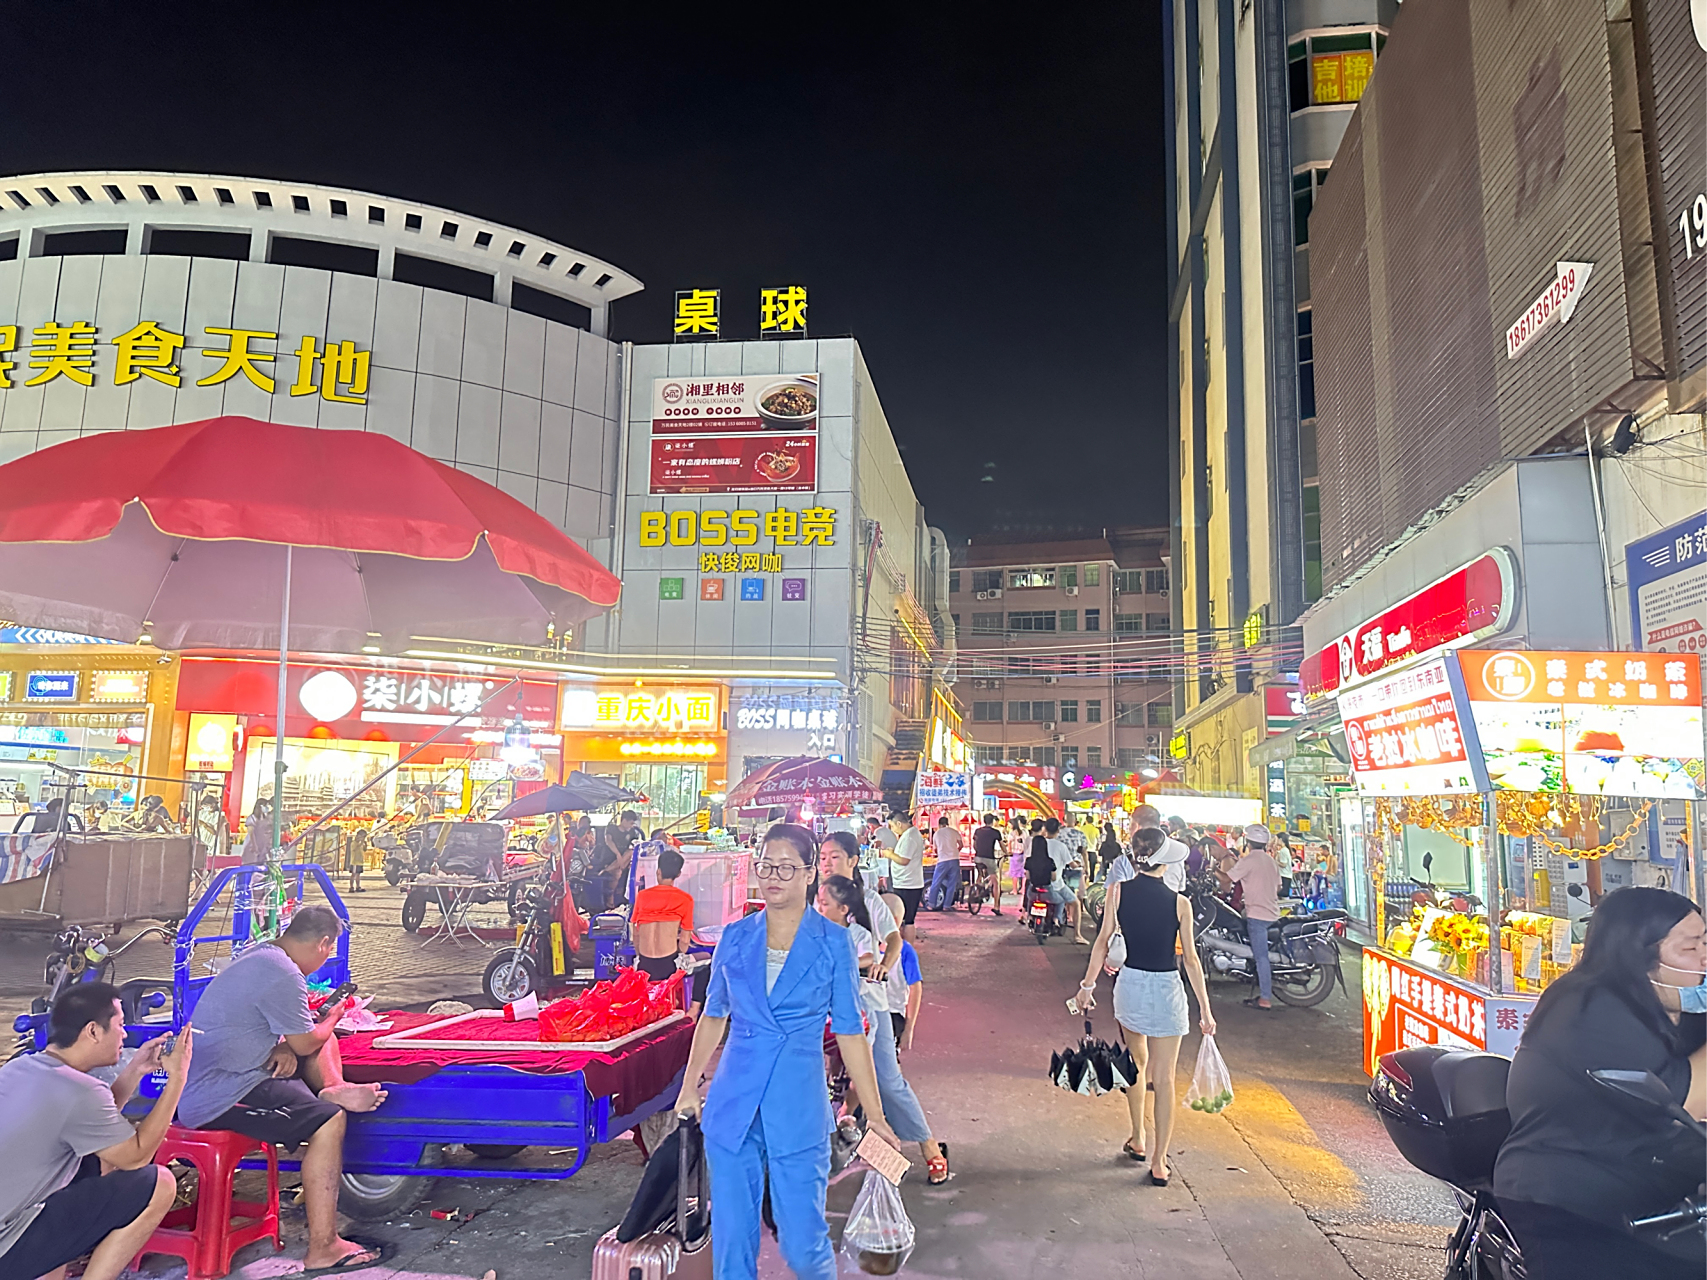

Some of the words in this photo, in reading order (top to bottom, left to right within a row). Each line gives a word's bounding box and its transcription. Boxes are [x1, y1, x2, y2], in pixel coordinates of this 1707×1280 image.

[674, 286, 808, 333] 桌球
[1508, 268, 1576, 352] 18617361299
[0, 321, 371, 405] 美食天地
[685, 381, 745, 397] 湘里相邻
[685, 397, 745, 405] XIANGLIXIANGLIN
[699, 552, 782, 573] 快俊网咖
[1361, 627, 1383, 664] 天福
[1545, 659, 1687, 682] 泰式奶茶
[596, 696, 713, 723] 重庆小面
[807, 733, 836, 748] 入口
[1368, 717, 1461, 767] 老挝冰咖啡
[920, 772, 966, 787] 海鲜之家
